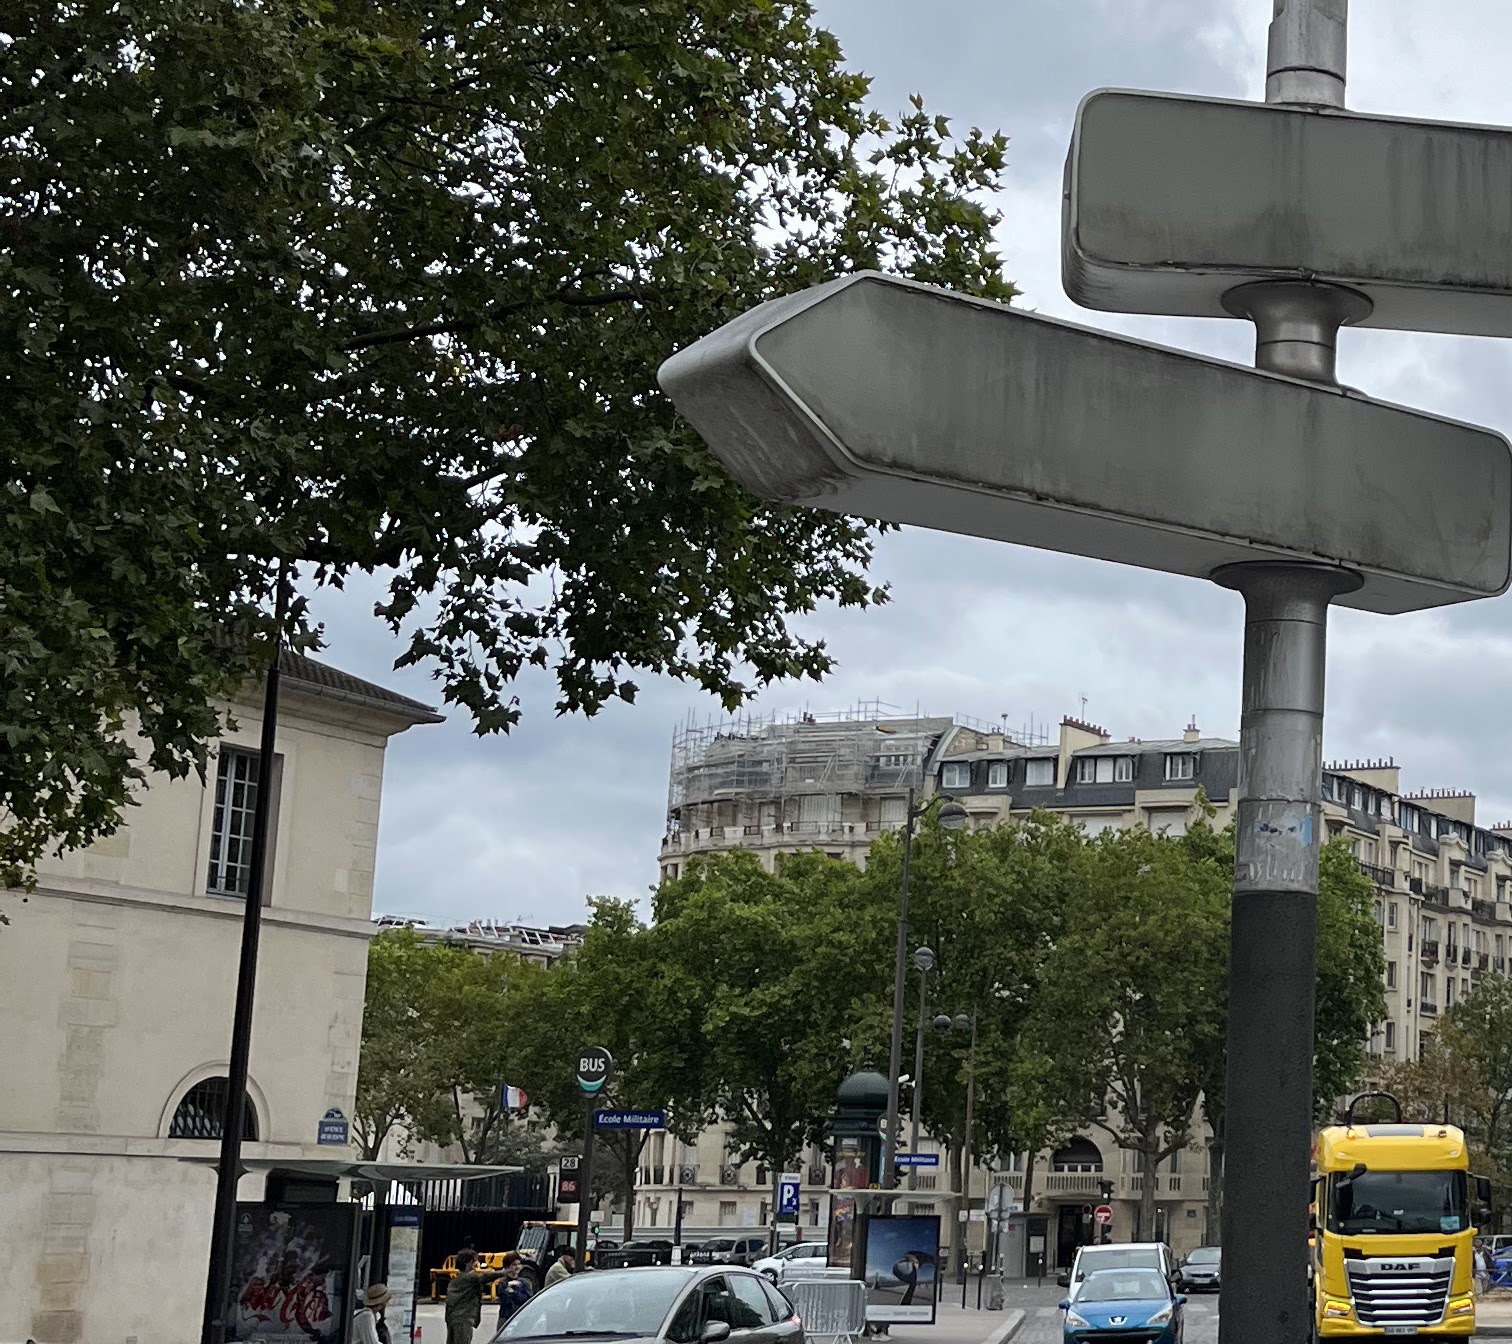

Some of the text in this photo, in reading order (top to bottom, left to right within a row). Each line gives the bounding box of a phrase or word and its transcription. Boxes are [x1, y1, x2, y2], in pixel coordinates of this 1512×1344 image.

[579, 1057, 606, 1072] BUS
[598, 1113, 660, 1124] École Militaire
[563, 1158, 576, 1168] 28
[561, 1181, 576, 1192] 86
[782, 1184, 795, 1206] P
[1380, 1262, 1421, 1271] DAF
